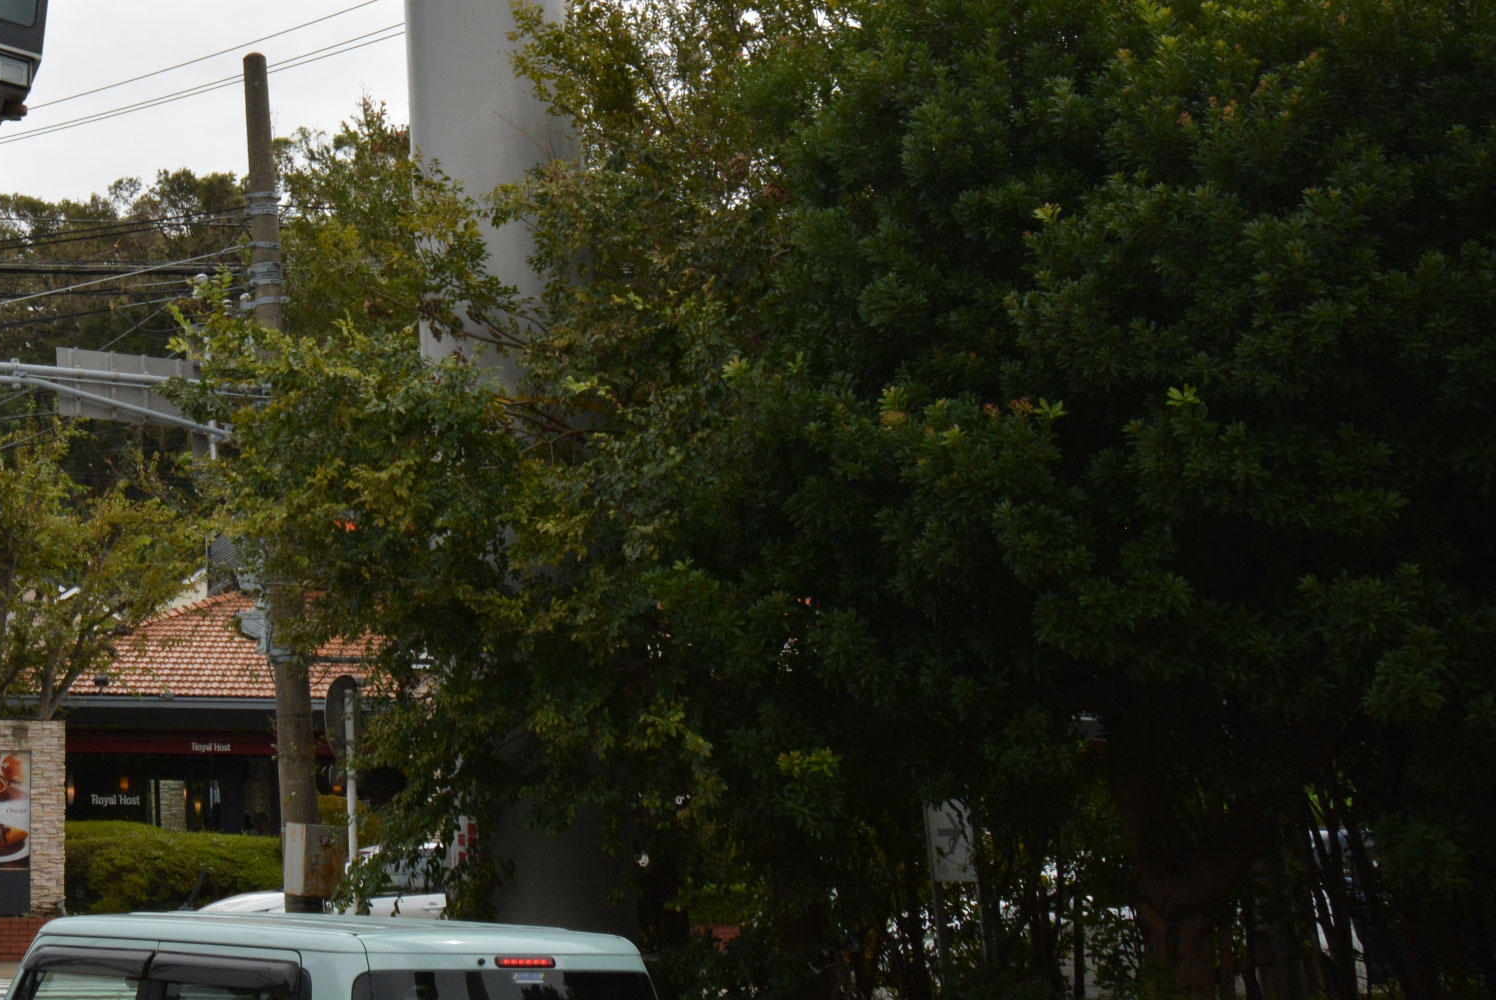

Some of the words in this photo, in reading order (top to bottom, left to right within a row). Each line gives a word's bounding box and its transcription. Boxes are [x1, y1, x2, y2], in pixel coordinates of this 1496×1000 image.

[192, 742, 213, 753] Royal
[214, 743, 231, 752] Host
[91, 794, 116, 807] Royal
[119, 795, 140, 806] Host
